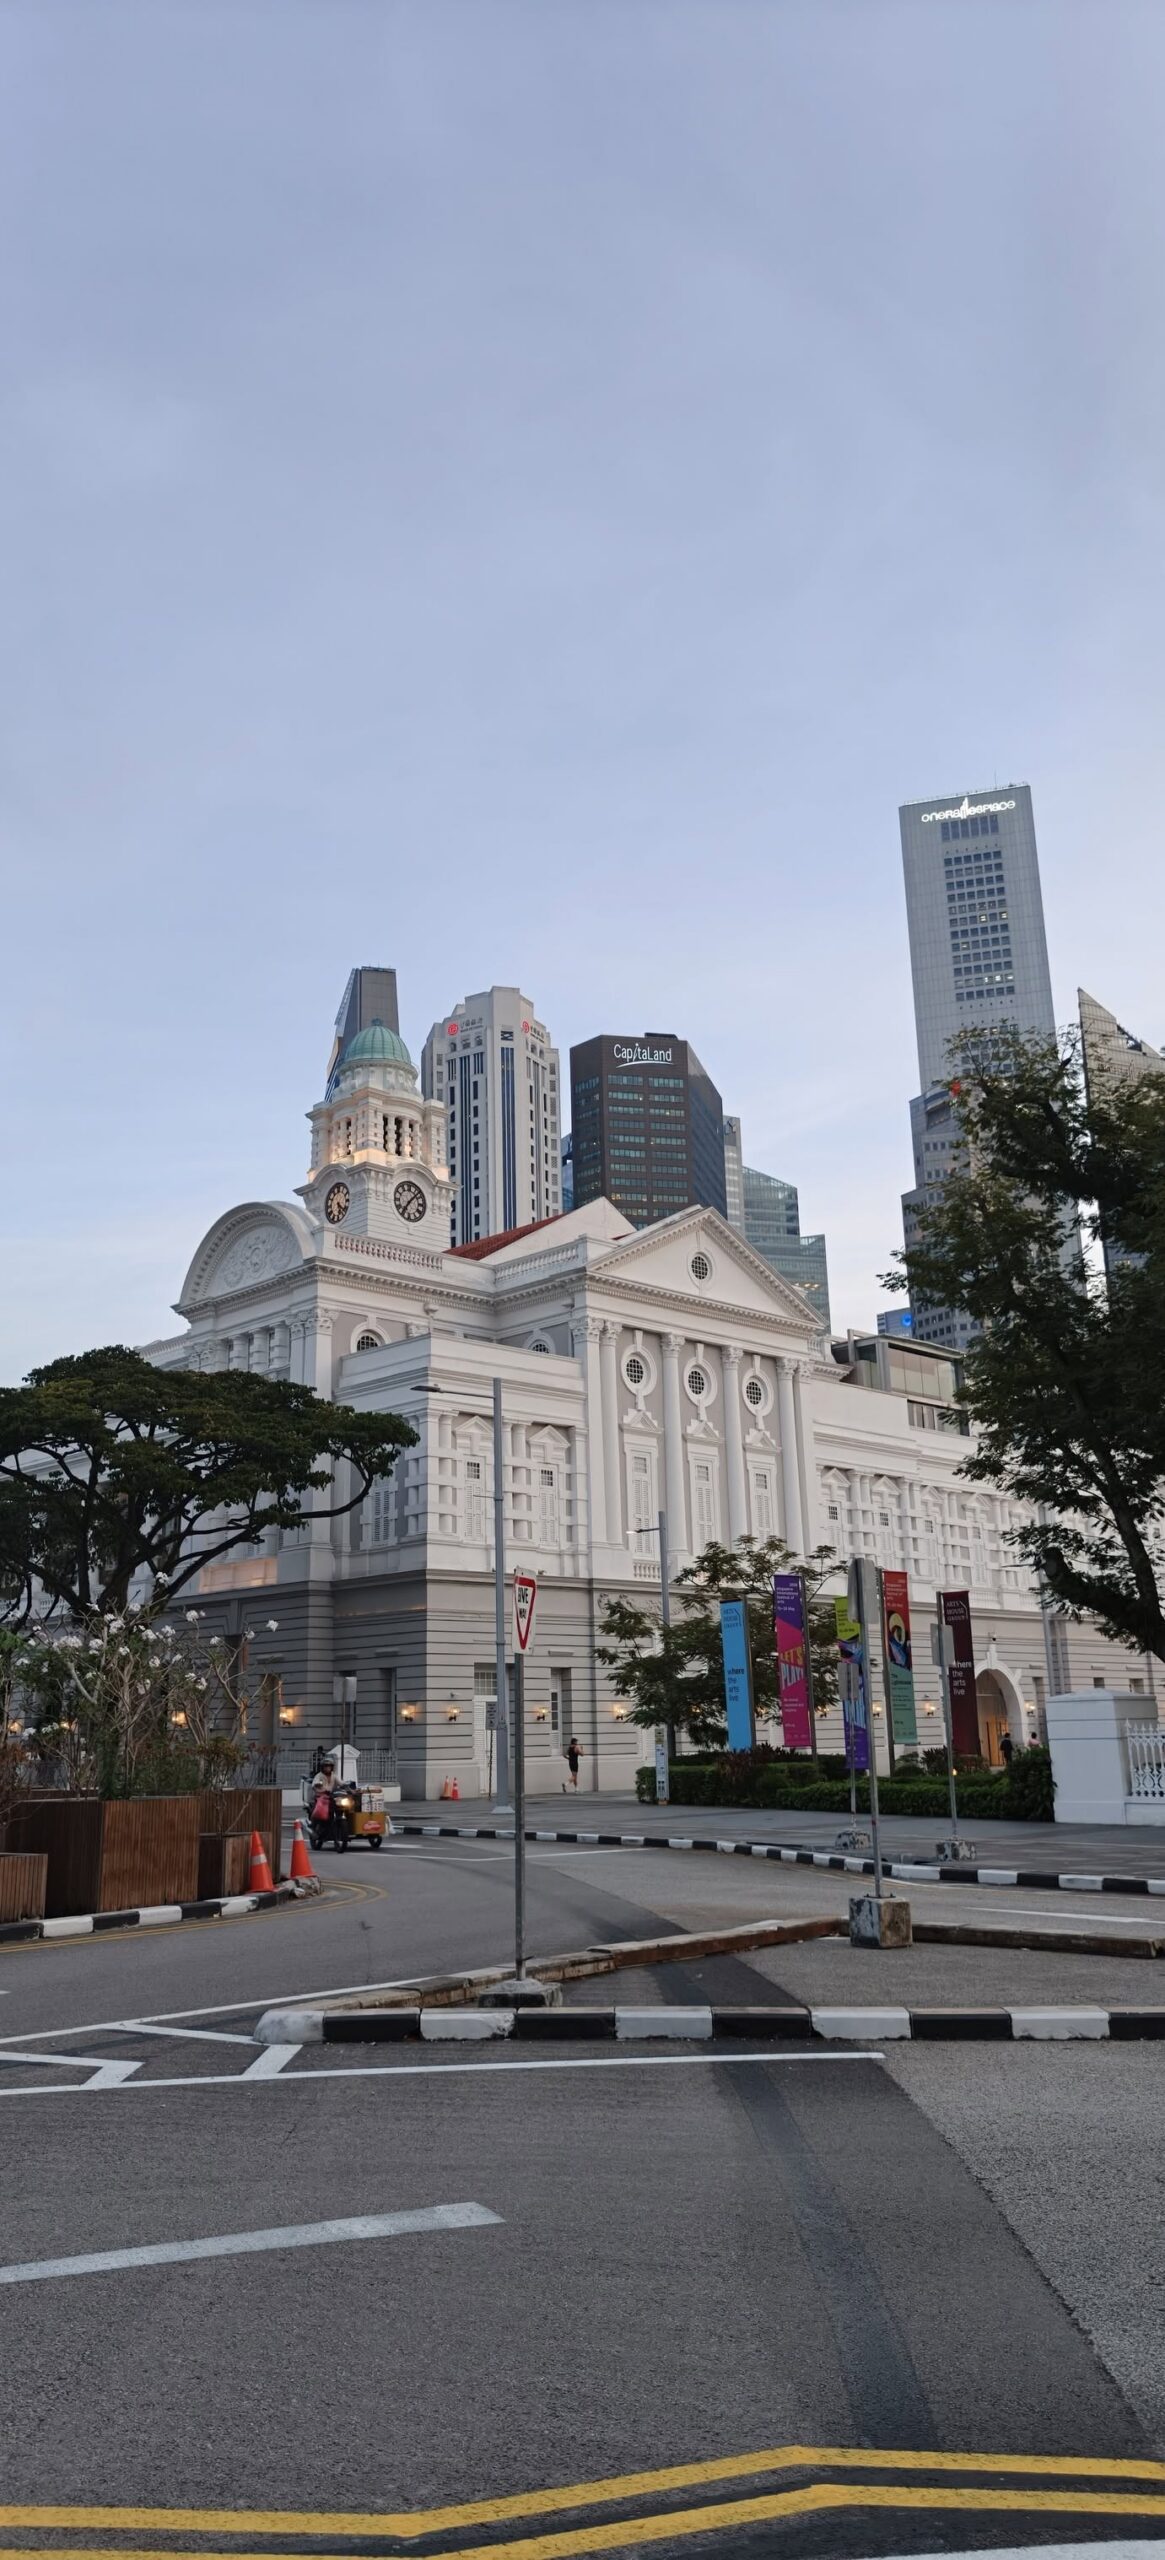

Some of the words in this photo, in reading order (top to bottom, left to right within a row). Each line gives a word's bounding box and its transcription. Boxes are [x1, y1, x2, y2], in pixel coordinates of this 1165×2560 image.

[613, 1042, 672, 1063] CapitaLand
[952, 1670, 964, 1678] the
[953, 1687, 966, 1696] live
